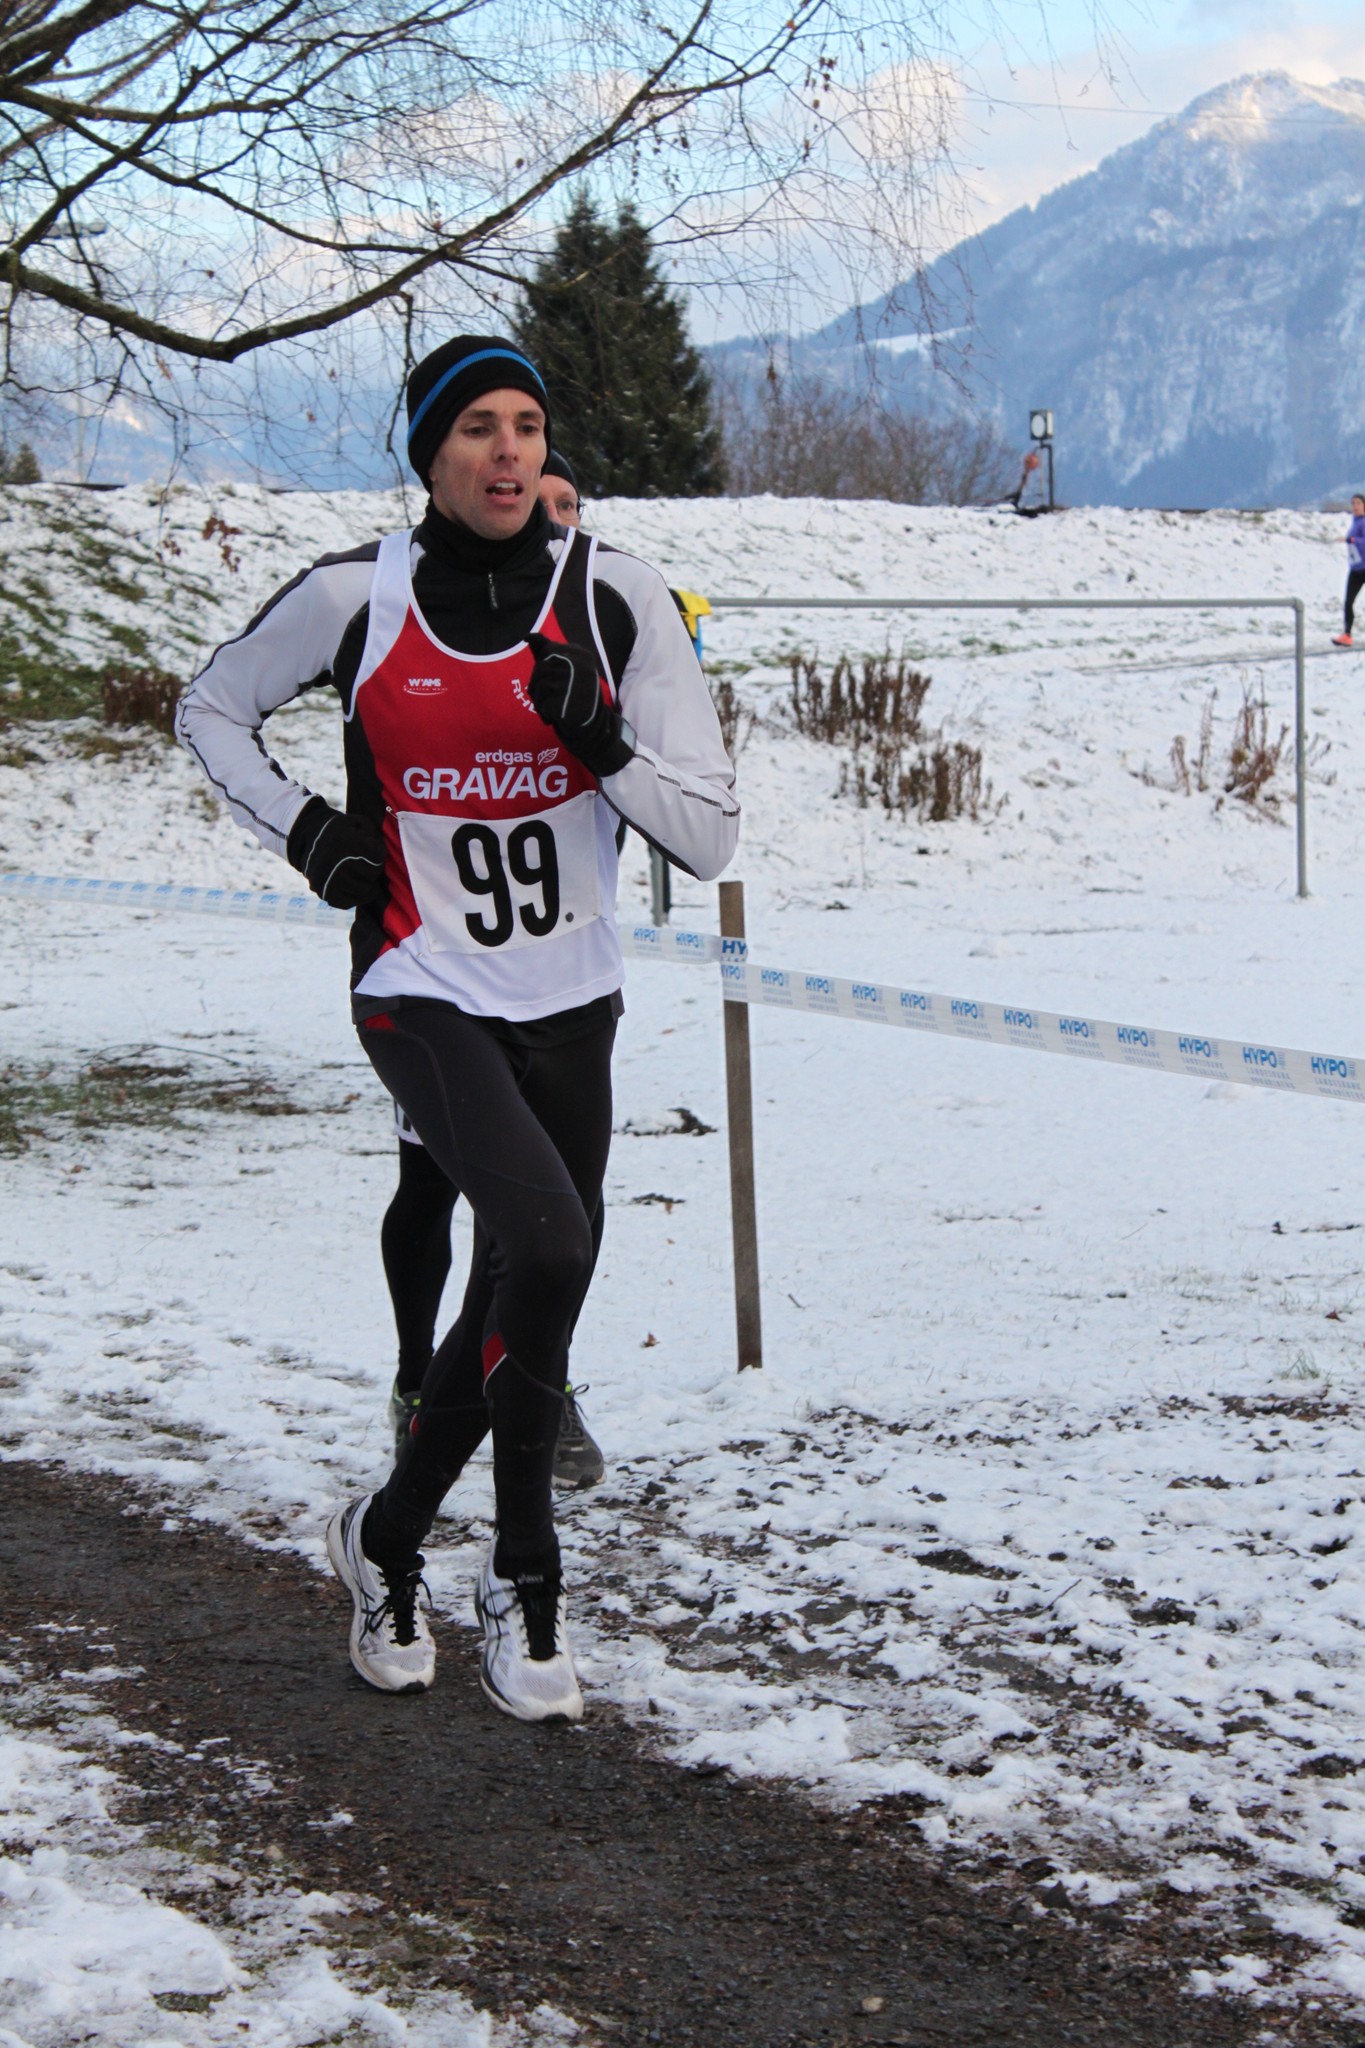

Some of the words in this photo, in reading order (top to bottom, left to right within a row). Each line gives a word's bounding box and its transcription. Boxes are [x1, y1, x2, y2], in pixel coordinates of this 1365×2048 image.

[475, 749, 533, 766] erdgas
[402, 765, 569, 801] GRAVAG
[761, 969, 785, 987] HYPO
[805, 976, 831, 994] HYPO
[852, 984, 878, 1002] HYPO
[901, 992, 927, 1010] HYPO
[951, 1000, 979, 1019] HYPO
[1003, 1009, 1033, 1029] HYPO
[1059, 1018, 1089, 1038] HYPO
[1117, 1026, 1150, 1047] HYPO
[1178, 1036, 1213, 1058] HYPO
[1242, 1046, 1278, 1069] HYPO
[1310, 1056, 1348, 1078] HYPO
